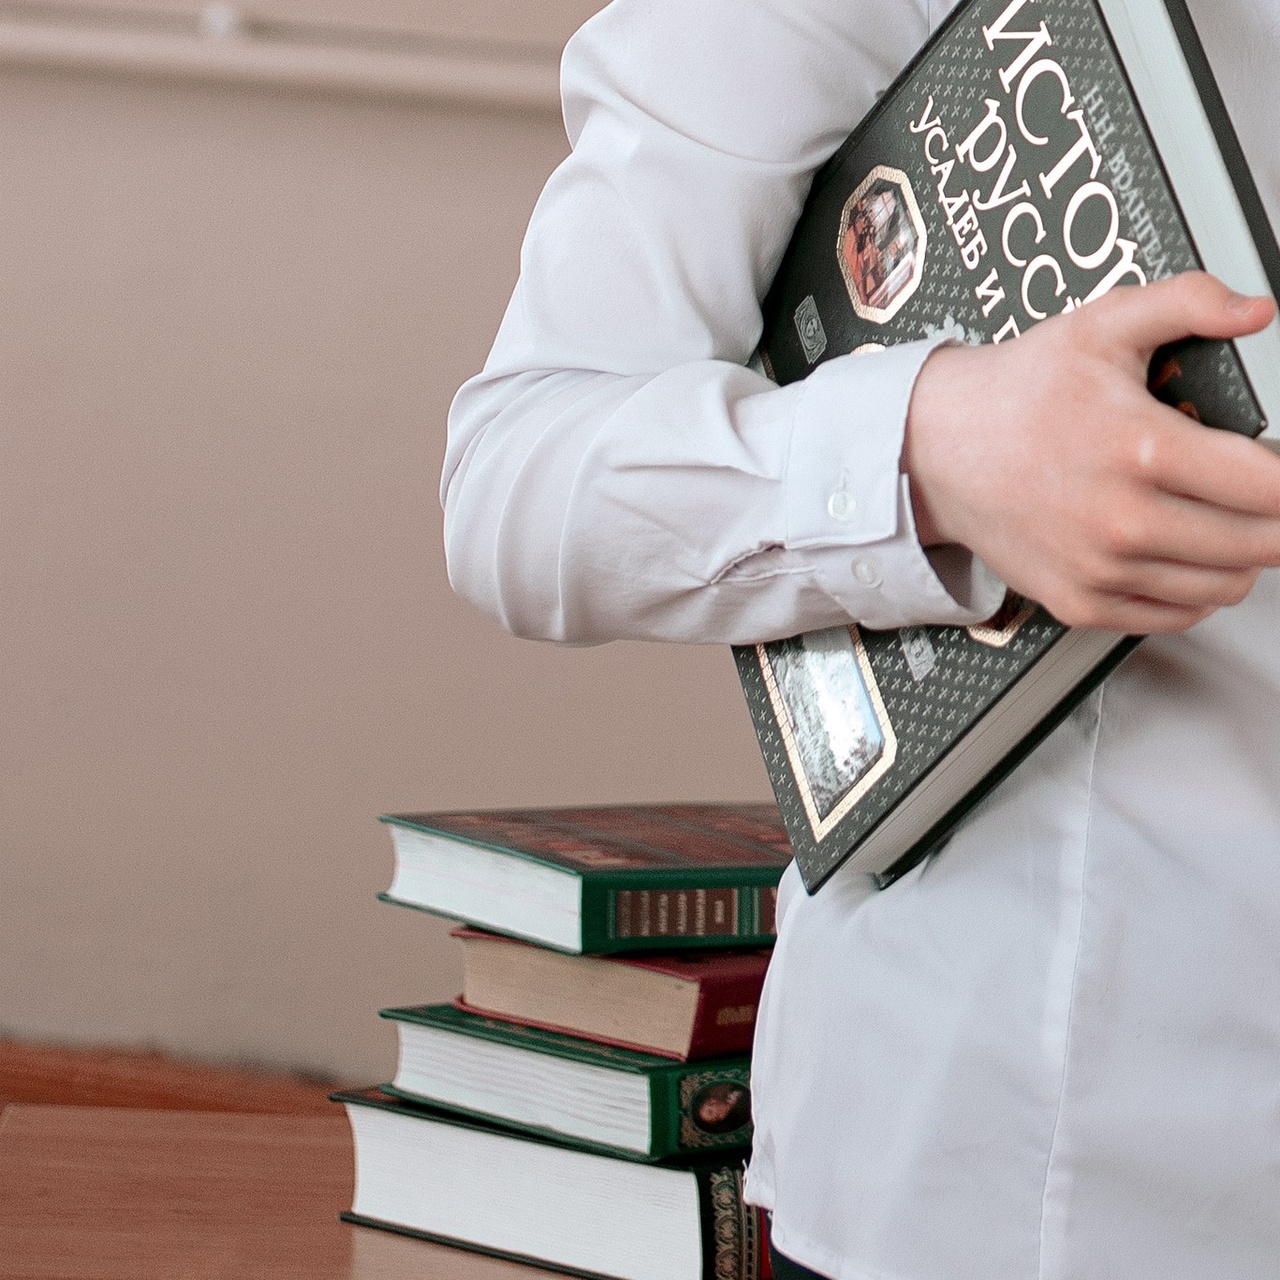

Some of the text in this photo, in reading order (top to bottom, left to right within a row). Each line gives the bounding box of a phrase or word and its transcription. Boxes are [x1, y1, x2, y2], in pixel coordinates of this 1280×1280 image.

[909, 95, 988, 270] УСАДЕБ
[955, 98, 1075, 319] РУСС
[1108, 147, 1174, 281] ВРАНГЕЛ
